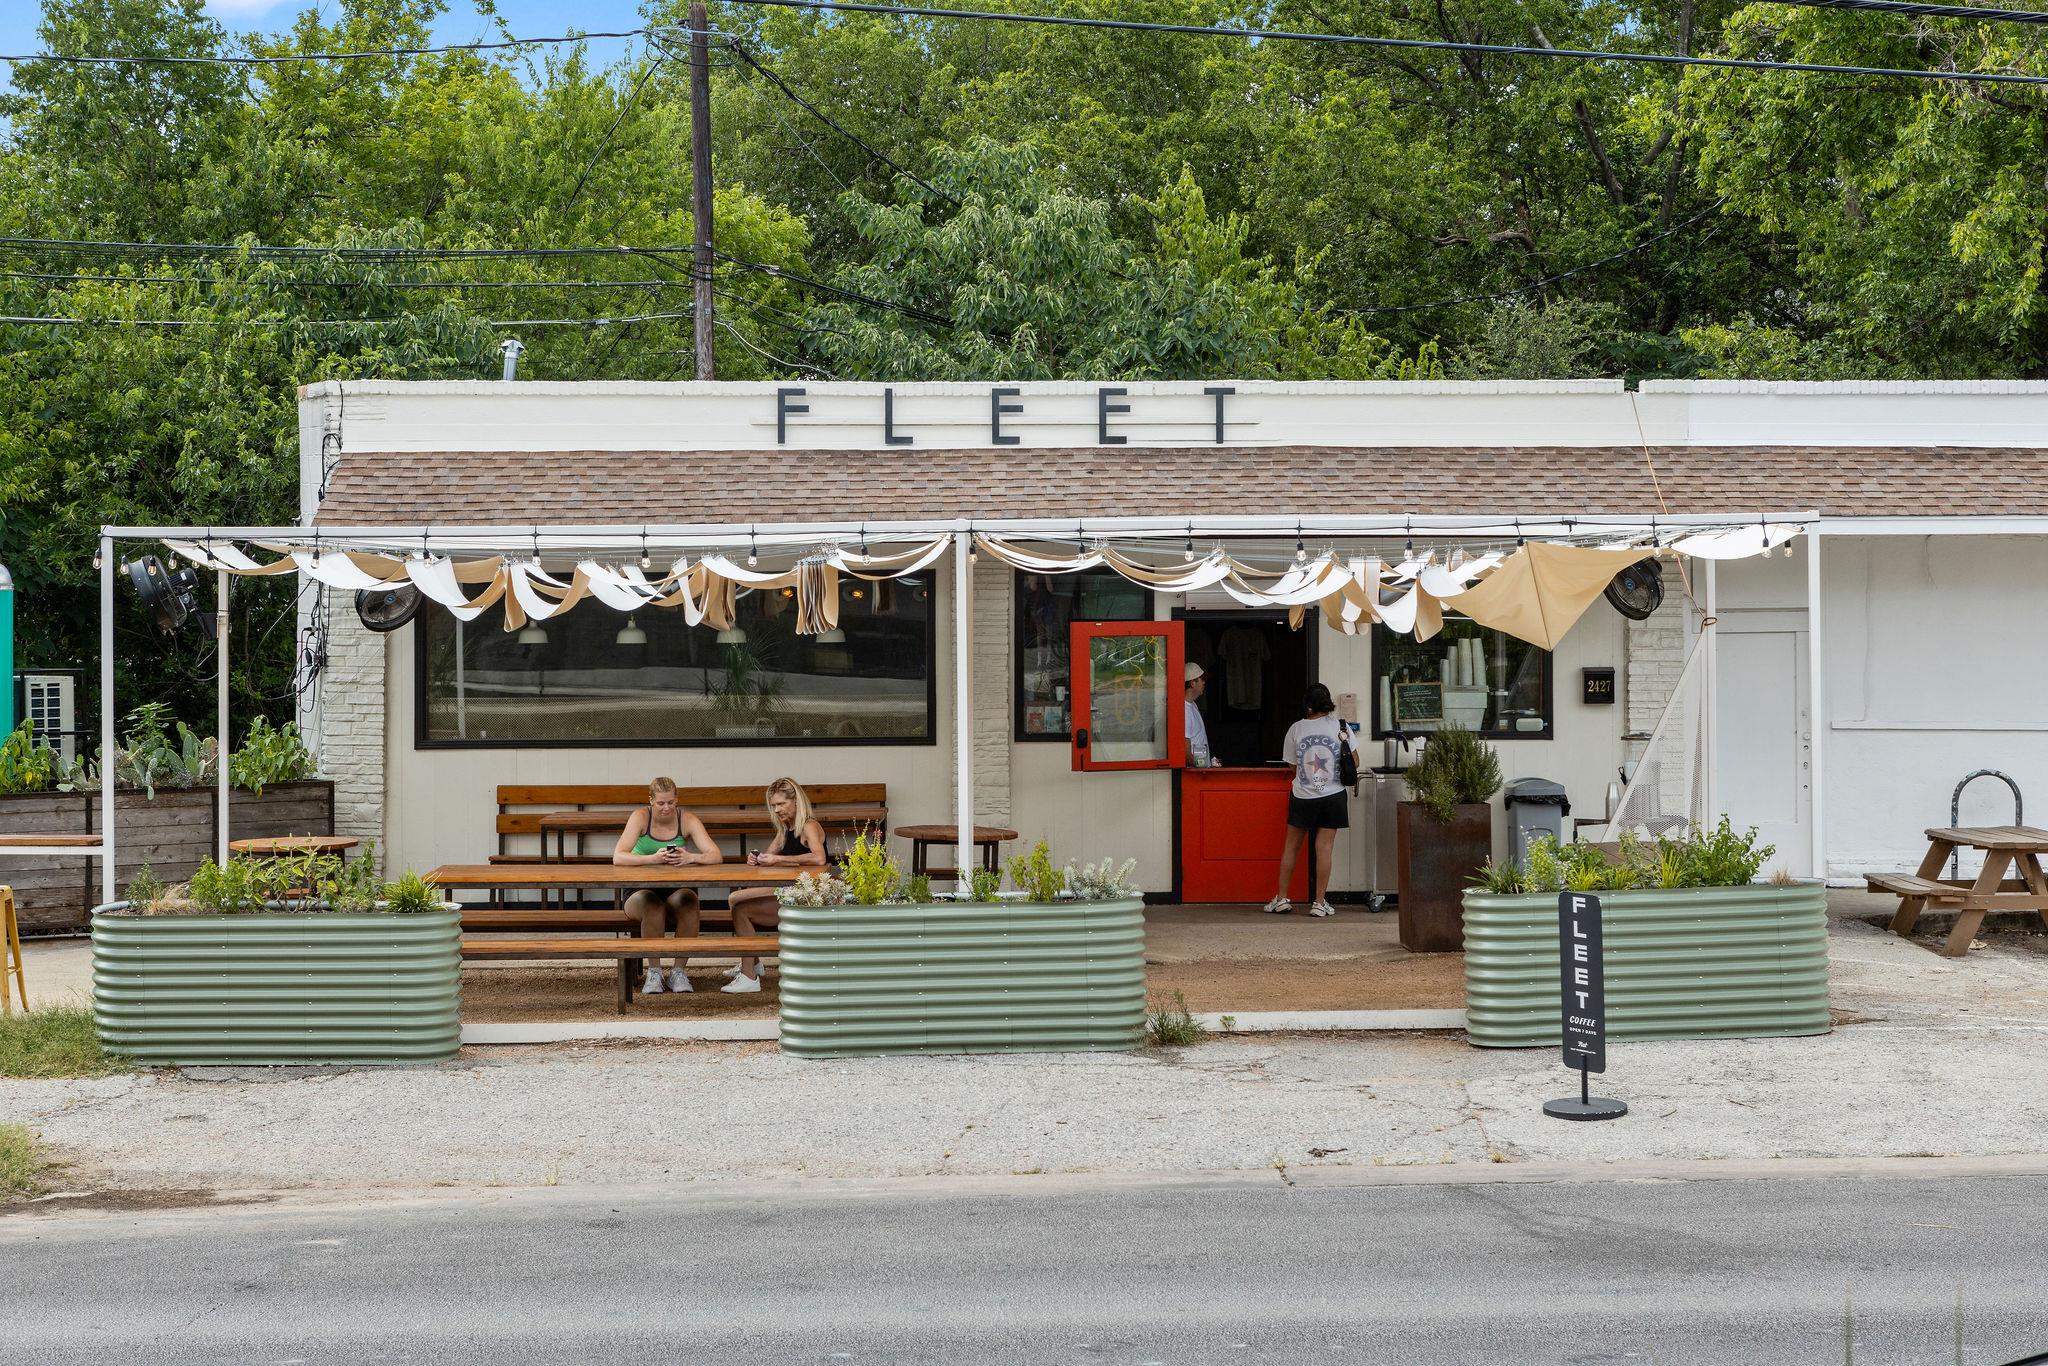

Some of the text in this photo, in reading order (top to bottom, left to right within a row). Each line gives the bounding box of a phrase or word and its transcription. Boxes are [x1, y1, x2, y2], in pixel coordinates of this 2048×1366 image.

[777, 387, 1236, 445] FLEET
[1588, 679, 1612, 692] 2427
[1571, 896, 1589, 1009] FLEET
[1569, 1015, 1597, 1027] COFFEE
